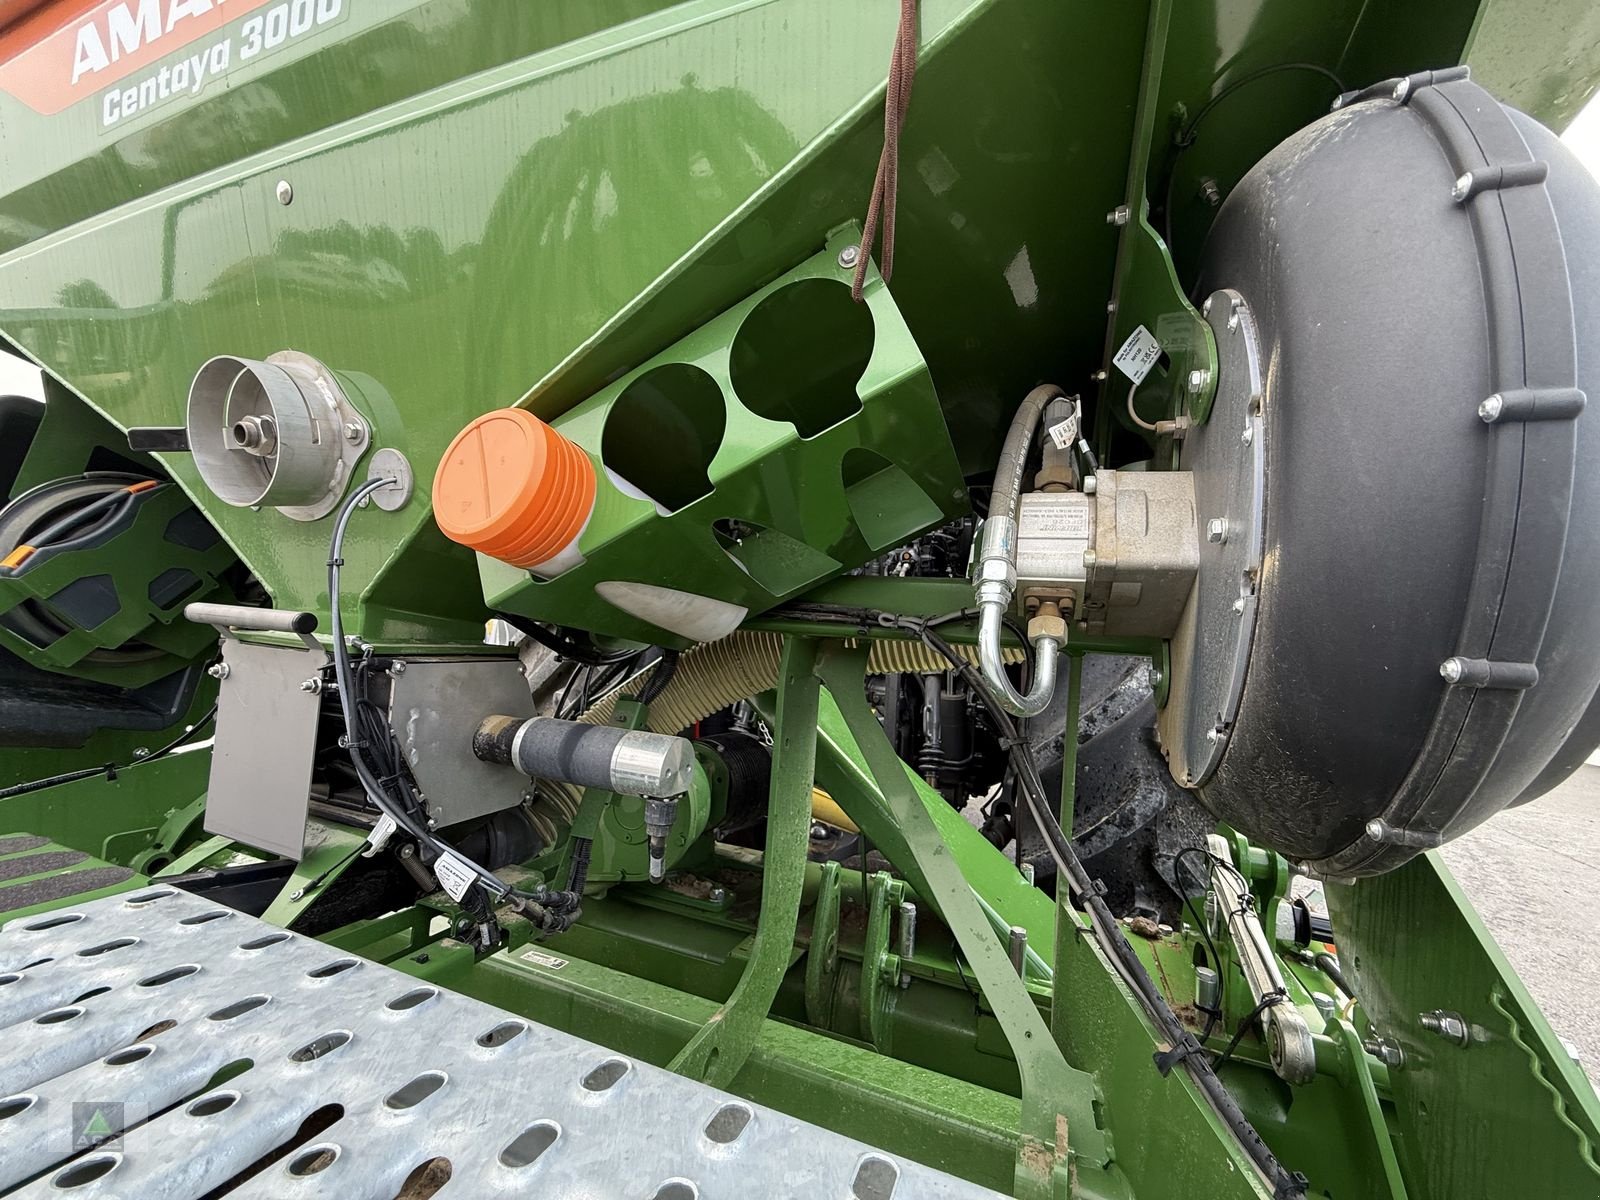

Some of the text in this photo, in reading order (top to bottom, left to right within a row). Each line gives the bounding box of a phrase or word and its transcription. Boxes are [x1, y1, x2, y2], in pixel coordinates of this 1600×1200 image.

[71, 0, 226, 85] AMA
[102, 0, 342, 127] Centaya 3000
